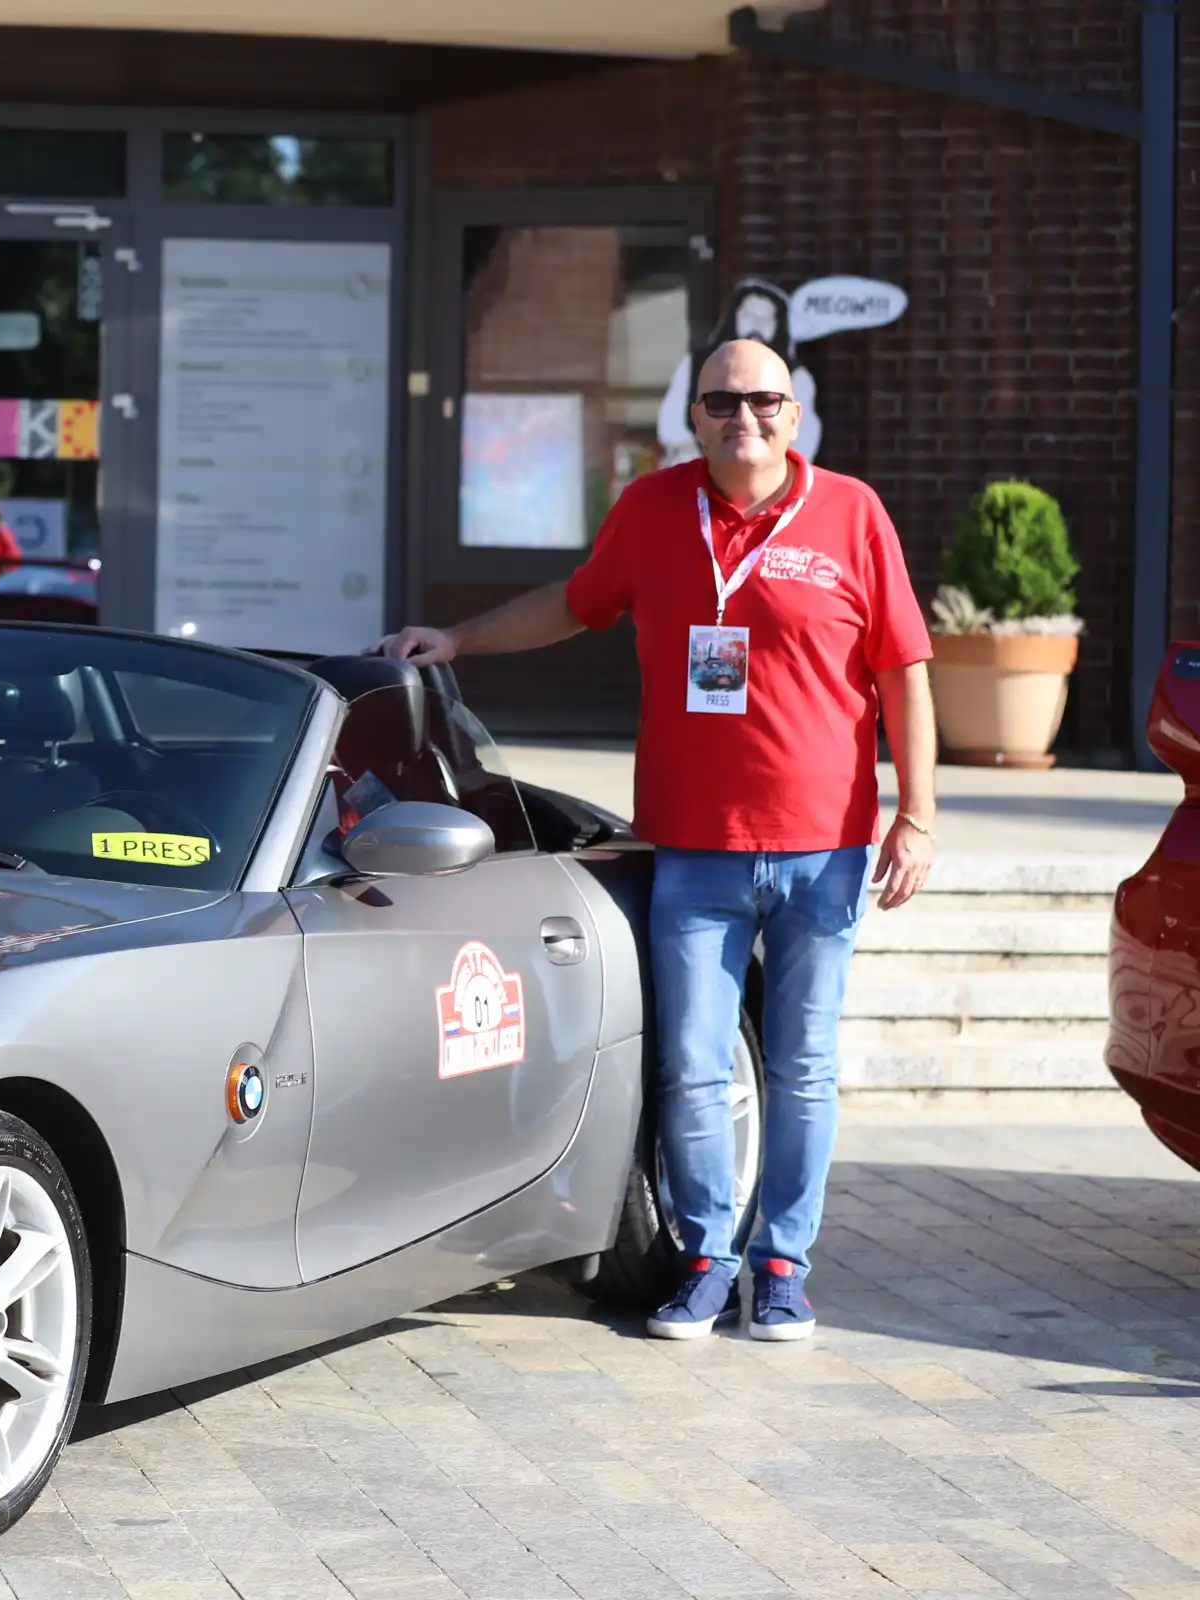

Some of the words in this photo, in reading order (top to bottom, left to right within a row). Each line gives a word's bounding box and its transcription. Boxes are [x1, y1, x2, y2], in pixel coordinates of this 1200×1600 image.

[763, 547, 813, 564] TOURIST
[759, 566, 797, 580] RALLY
[762, 557, 809, 574] TROPHY
[705, 694, 730, 707] PRESS
[99, 838, 112, 854] 1
[122, 840, 209, 863] PRESS
[474, 995, 491, 1028] 01
